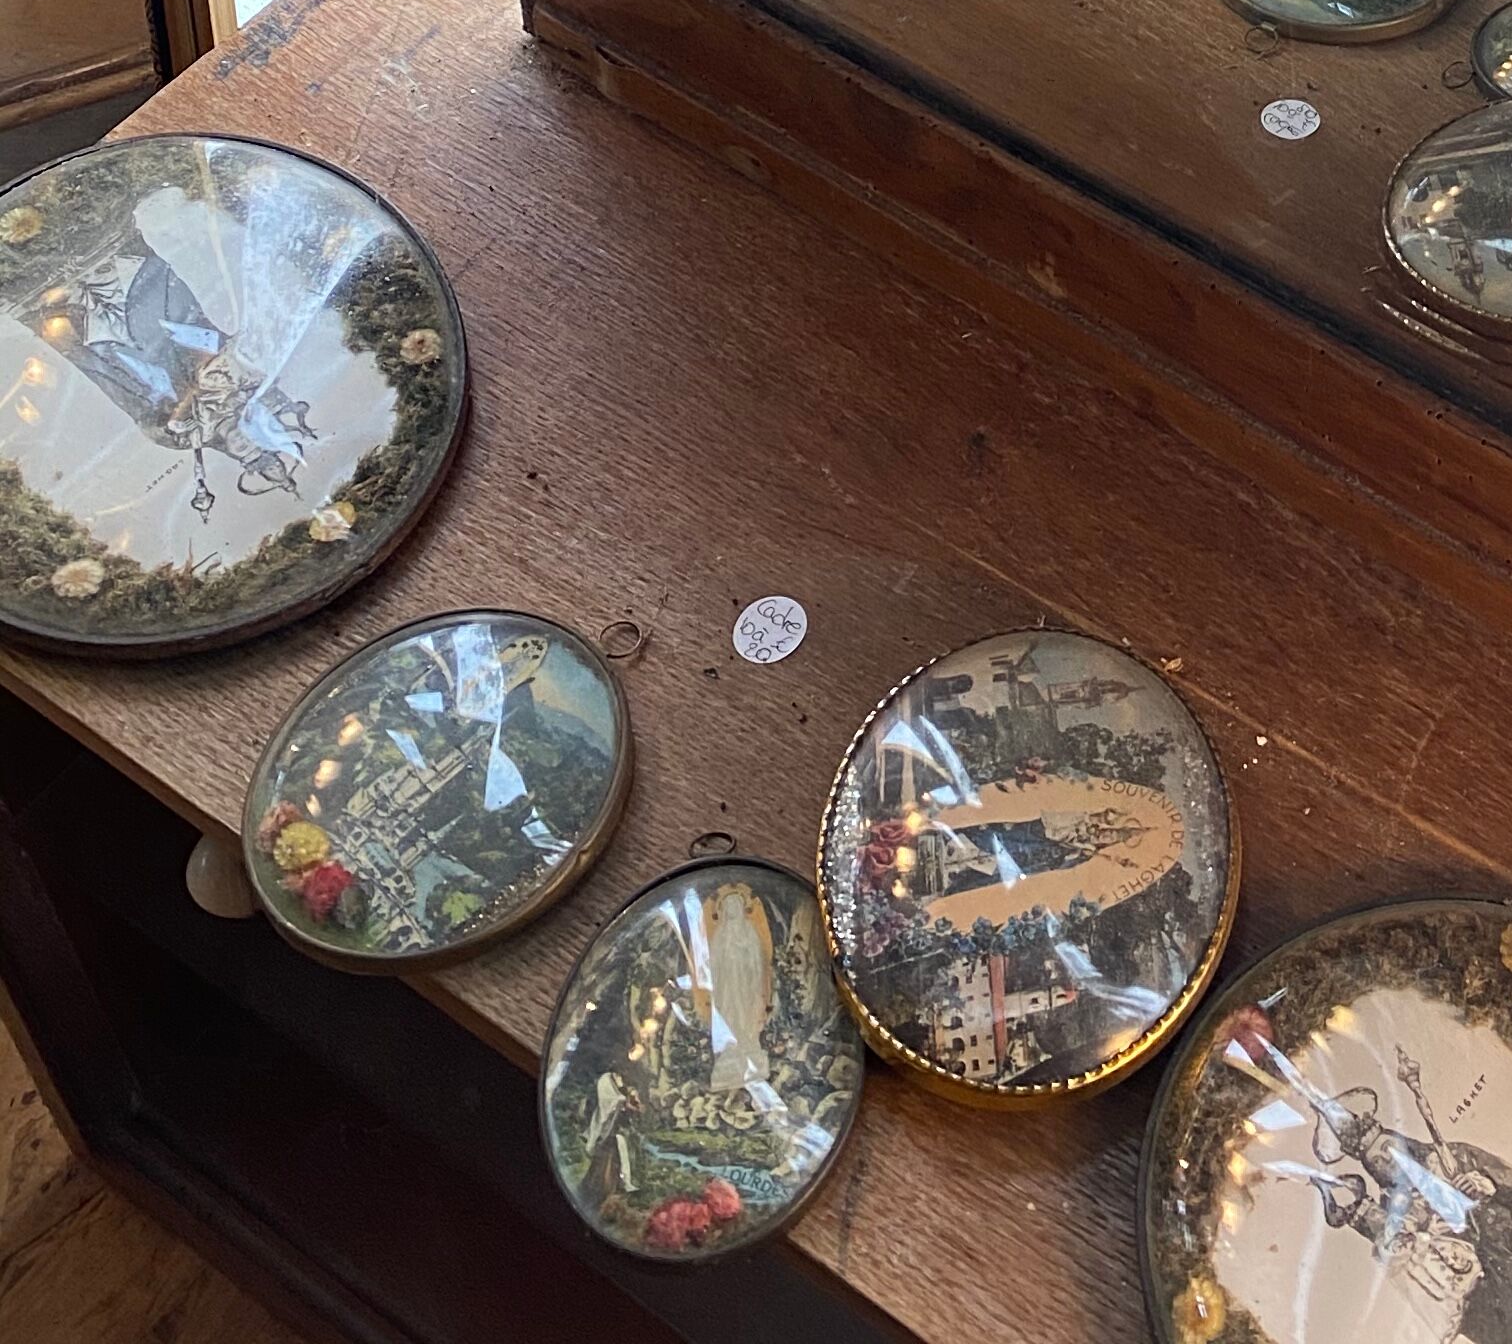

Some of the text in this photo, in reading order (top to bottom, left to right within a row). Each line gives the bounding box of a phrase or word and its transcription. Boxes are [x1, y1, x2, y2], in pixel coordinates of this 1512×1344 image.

[1100, 778, 1184, 901] SOUVENIR DE LAGHET
[1448, 1073, 1487, 1123] LAGHET
[722, 1165, 792, 1198] LOURDES
